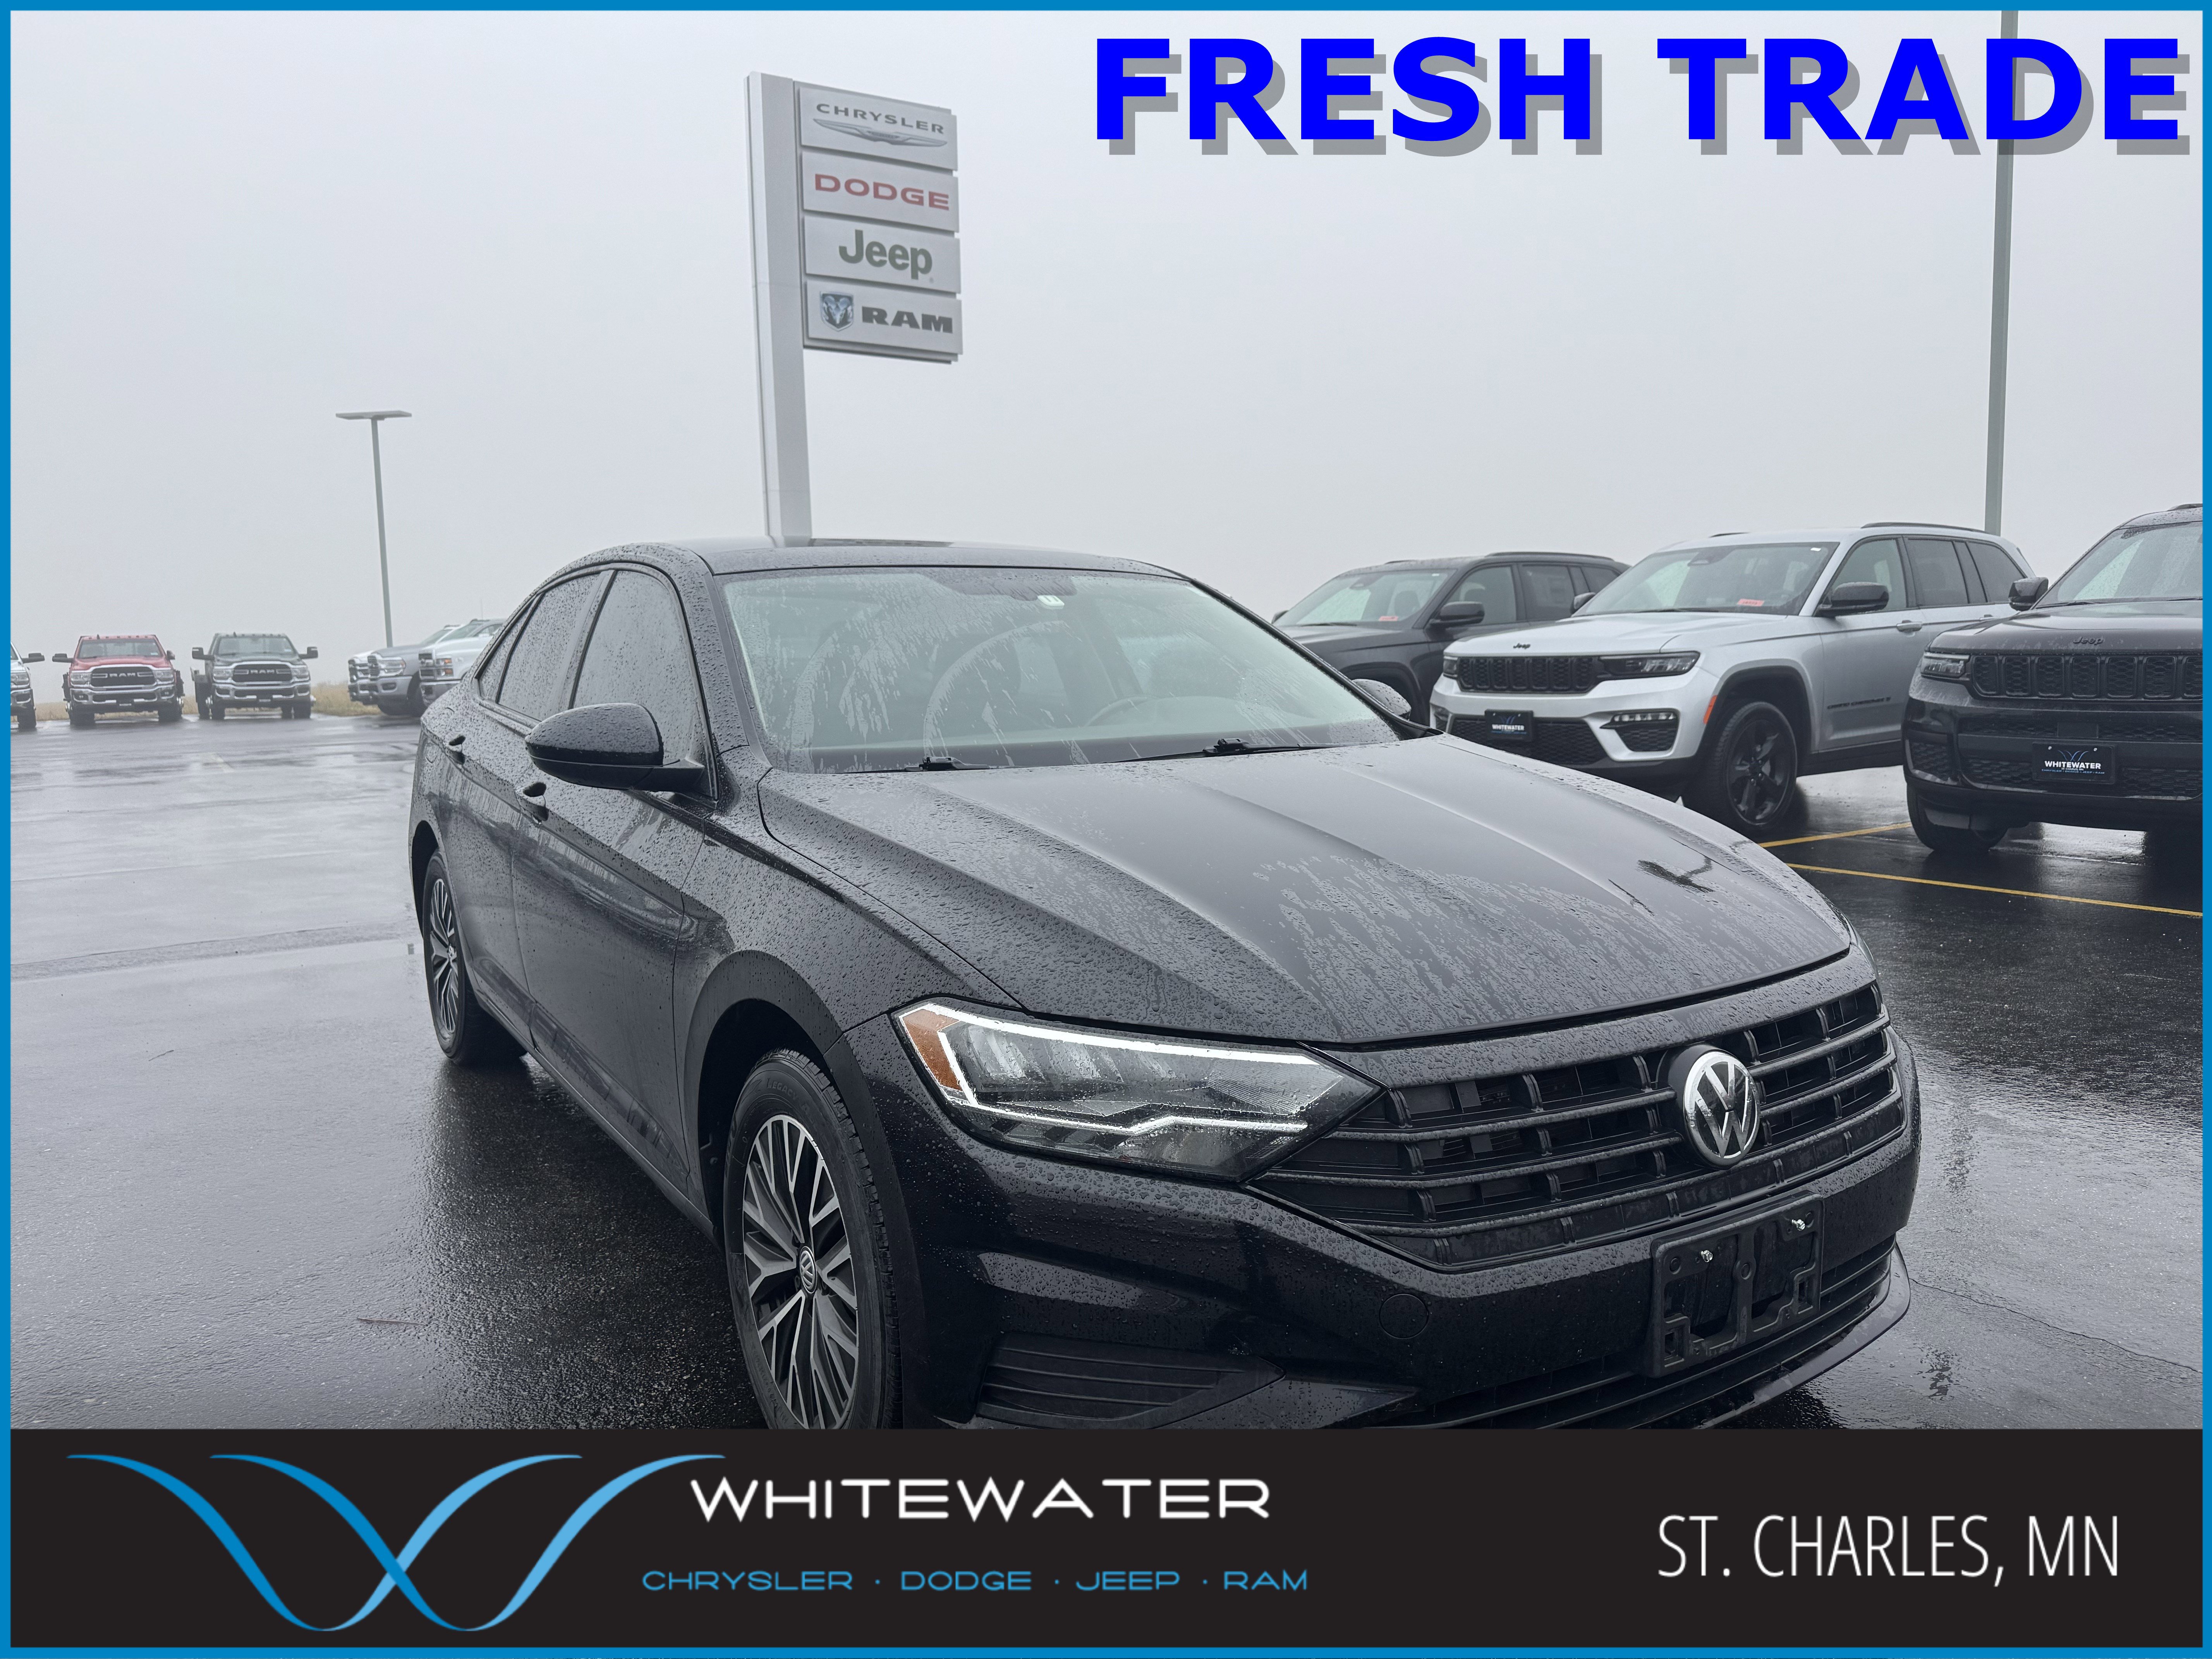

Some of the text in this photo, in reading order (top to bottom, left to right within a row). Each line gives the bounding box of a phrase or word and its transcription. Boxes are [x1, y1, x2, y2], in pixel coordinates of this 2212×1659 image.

[816, 103, 944, 134] CHRYSLER
[815, 174, 950, 210] DODGE
[839, 229, 933, 280] Jeep
[862, 306, 953, 333] RAM
[2073, 636, 2105, 646] Jeep
[2044, 761, 2102, 769] WHITEWATER
